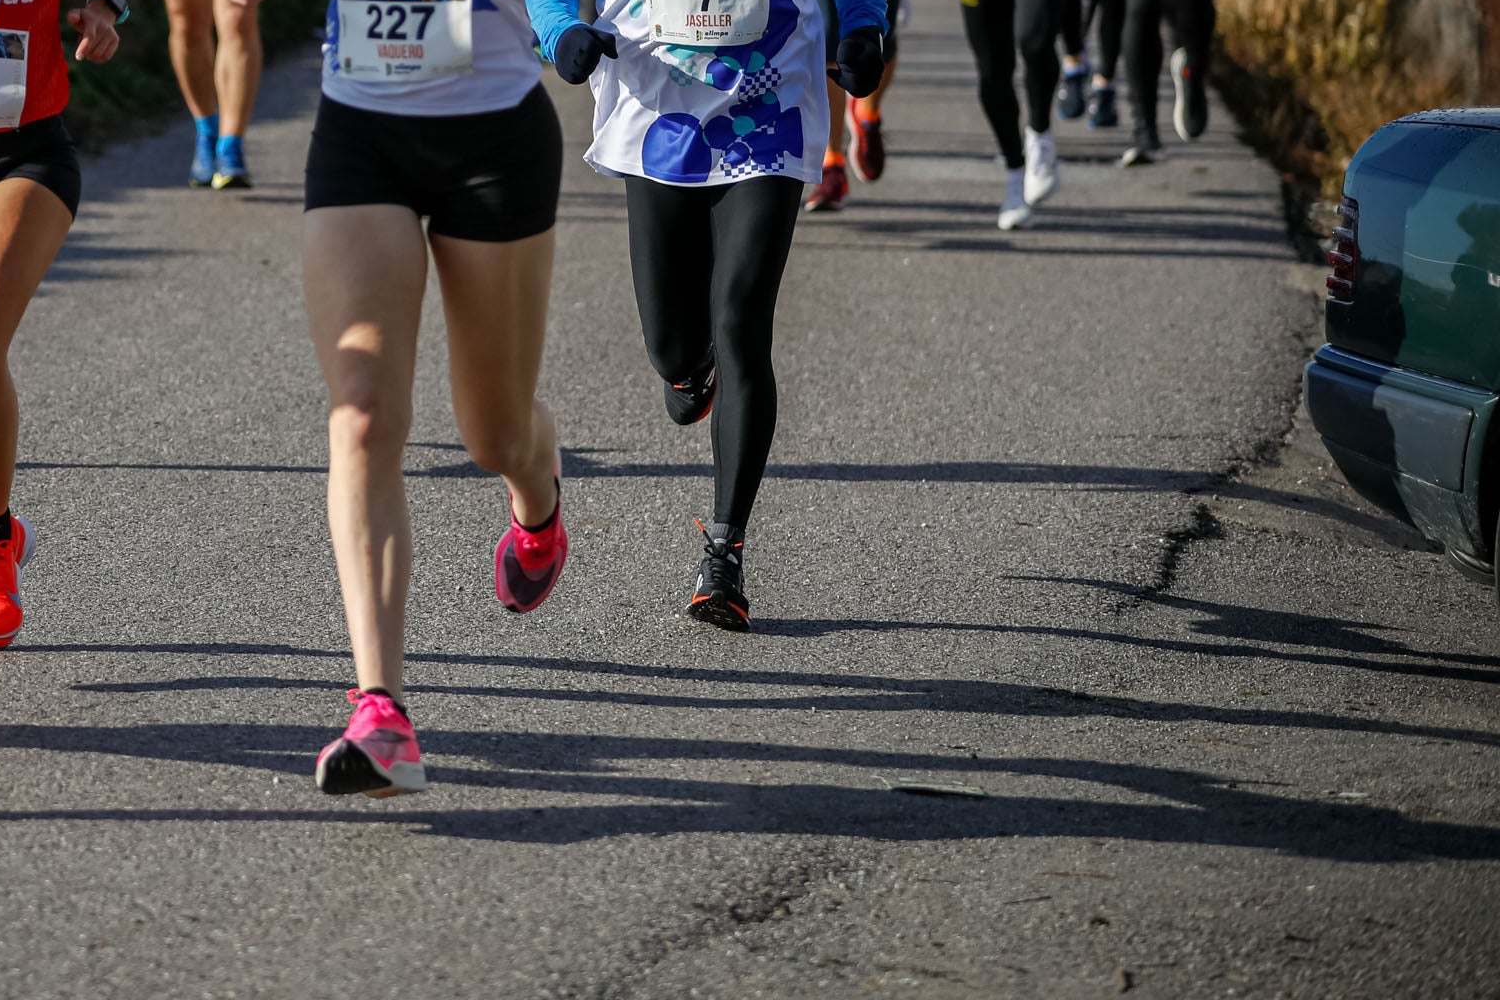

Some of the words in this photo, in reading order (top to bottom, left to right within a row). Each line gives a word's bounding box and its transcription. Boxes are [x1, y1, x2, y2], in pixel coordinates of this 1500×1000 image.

[366, 3, 435, 40] 227
[685, 14, 732, 27] JASELLER
[377, 44, 425, 59] VAQUERO
